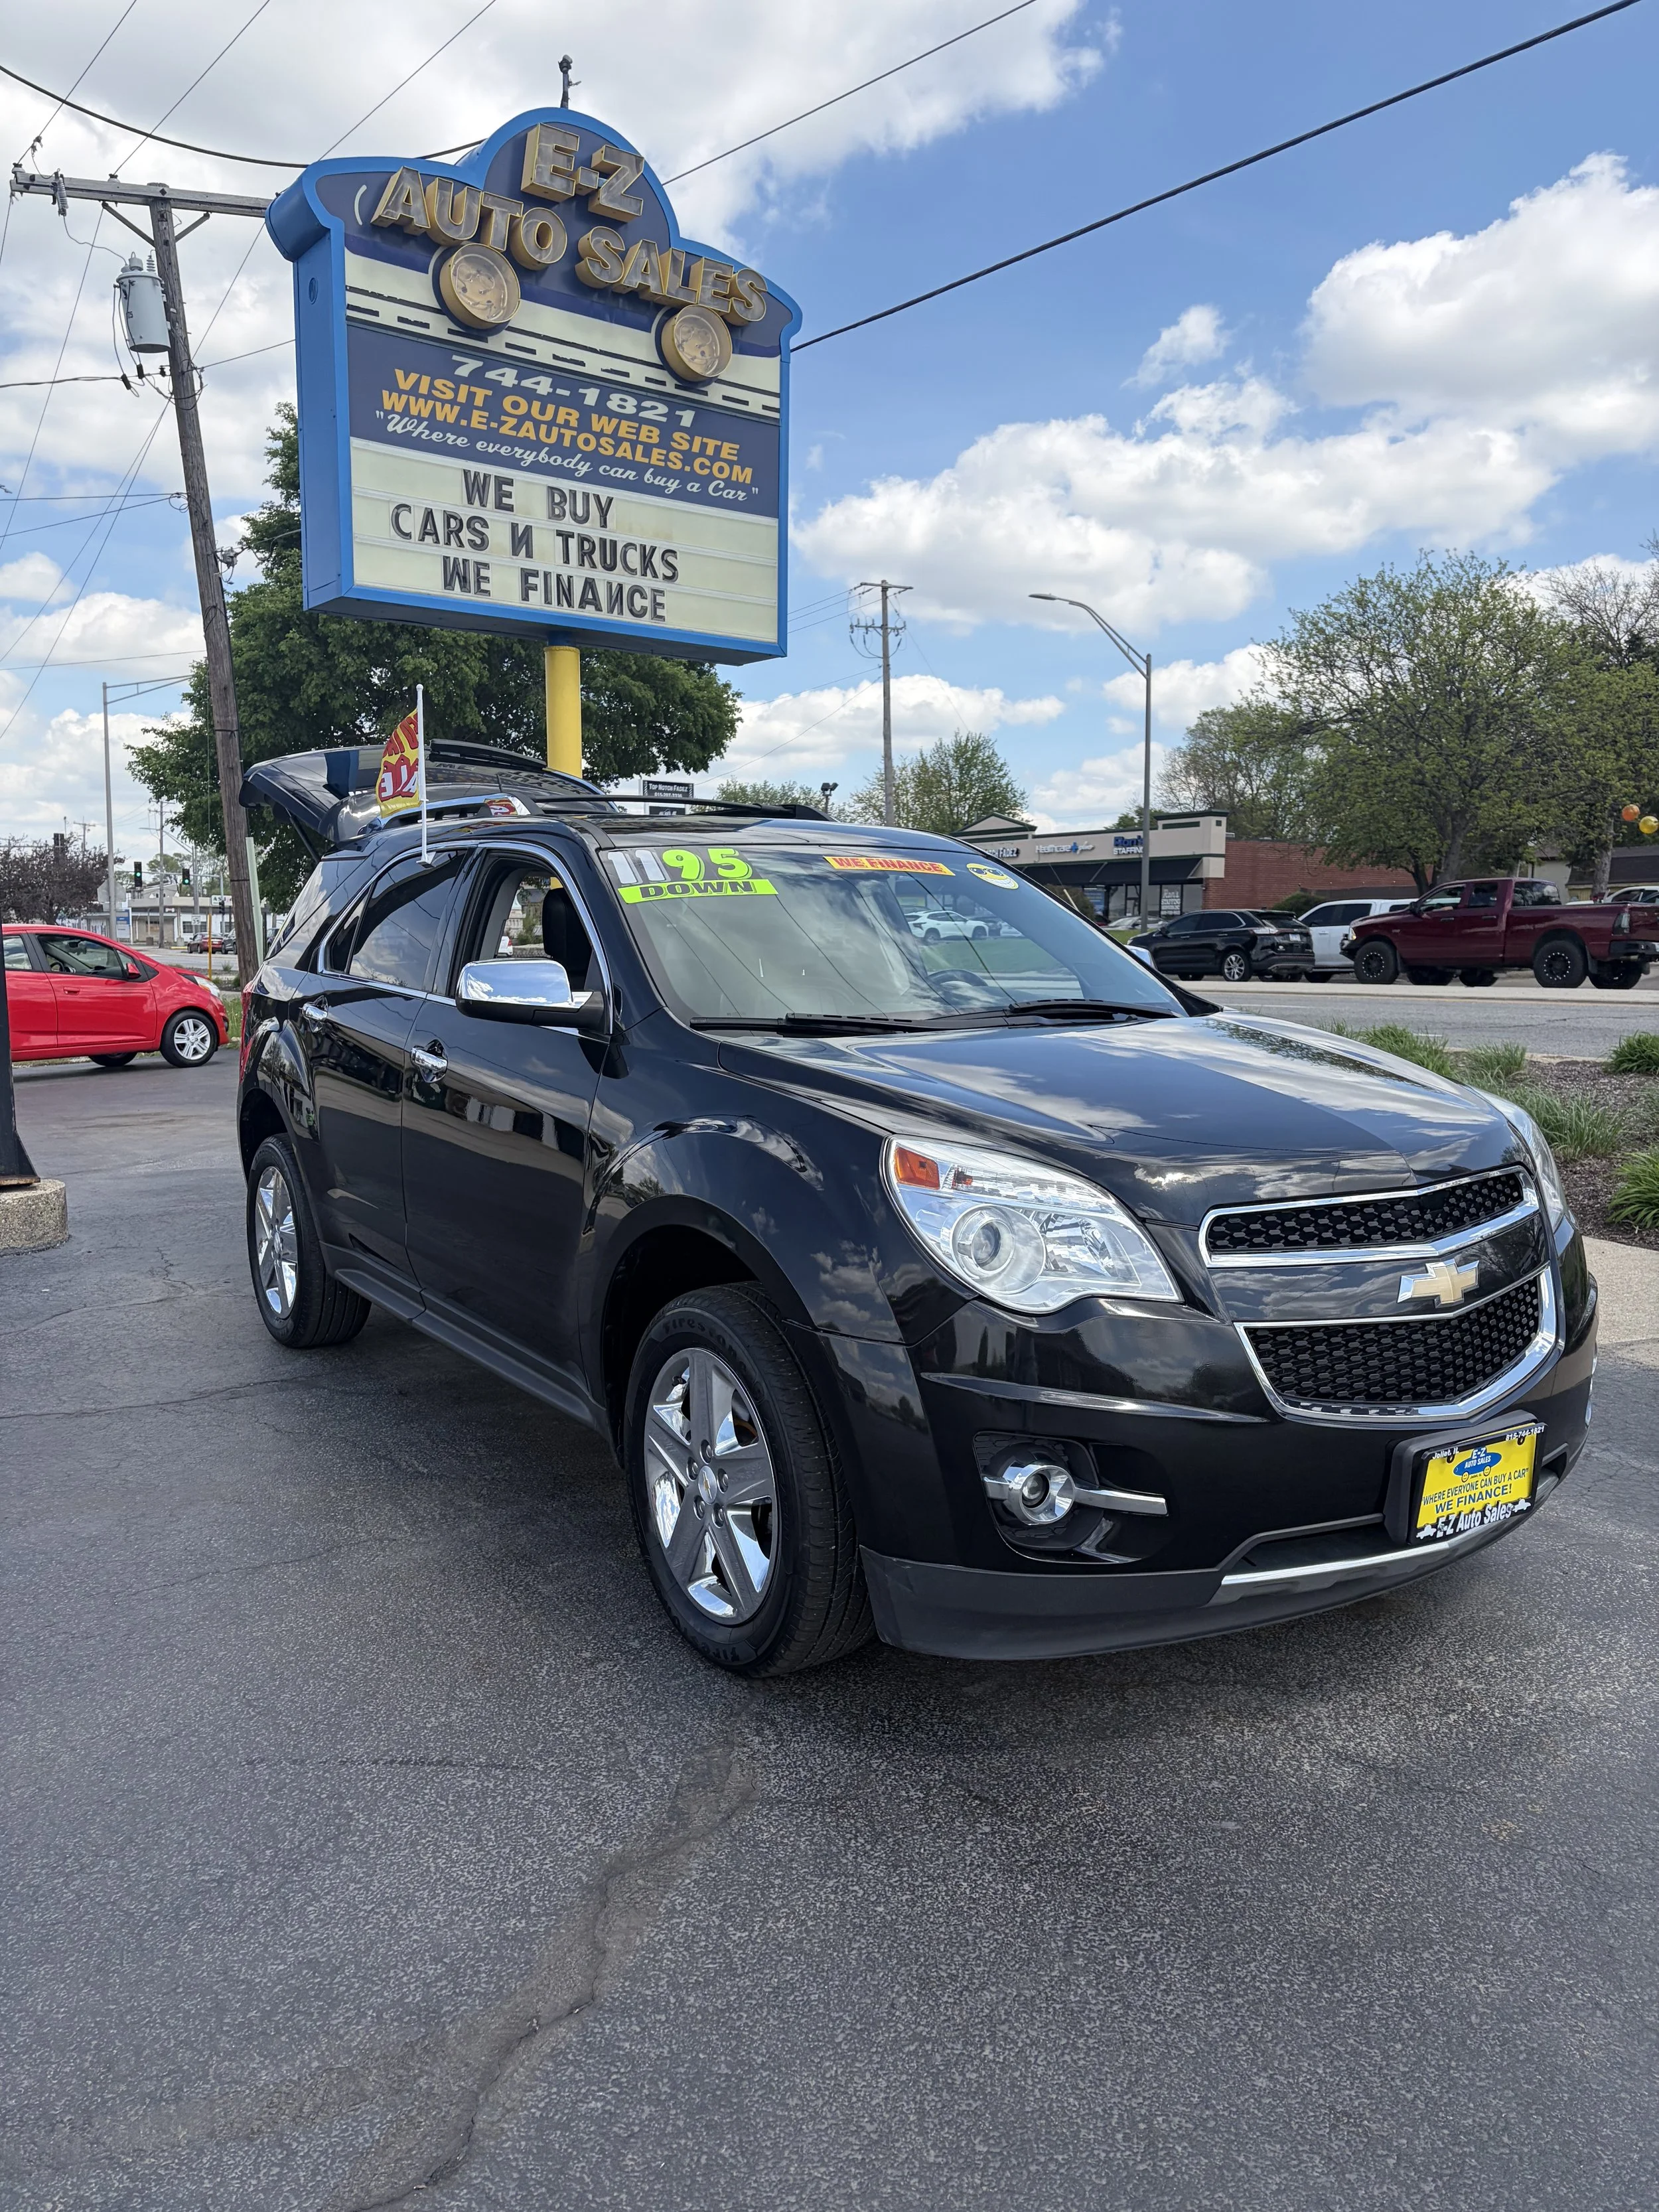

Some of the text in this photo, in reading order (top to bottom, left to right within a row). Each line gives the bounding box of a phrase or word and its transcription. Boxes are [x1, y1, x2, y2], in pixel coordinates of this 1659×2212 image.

[520, 122, 644, 222] E-Z
[370, 166, 768, 326] AUTO SALES
[394, 368, 740, 461] VISIT OUR WEB SITE
[451, 354, 696, 428] 744-1821
[375, 409, 758, 502] "Where everybody can buy a Car"
[382, 390, 753, 484] WWW.E-ZAUTOSALES.COM
[463, 469, 614, 530] WE BUY
[391, 503, 489, 551] CARS
[555, 529, 679, 583] TRUCKS
[442, 555, 667, 623] WE FINANCE
[639, 881, 757, 899] DOWN
[832, 857, 943, 873] WE FINANCE
[1464, 1455, 1491, 1469] AUTO SALES
[1471, 1447, 1488, 1459] E-Z
[1506, 1426, 1545, 1441] 815-744-1821
[1435, 1483, 1512, 1515] WE FINANCE!
[1447, 1479, 1479, 1499] EVERYONE
[1480, 1476, 1492, 1489] CAN
[1493, 1472, 1506, 1486] BUY
[1507, 1470, 1512, 1481] A
[1513, 1467, 1529, 1480] CAR"
[1455, 1510, 1481, 1533] Auto
[1484, 1501, 1512, 1524] Sales
